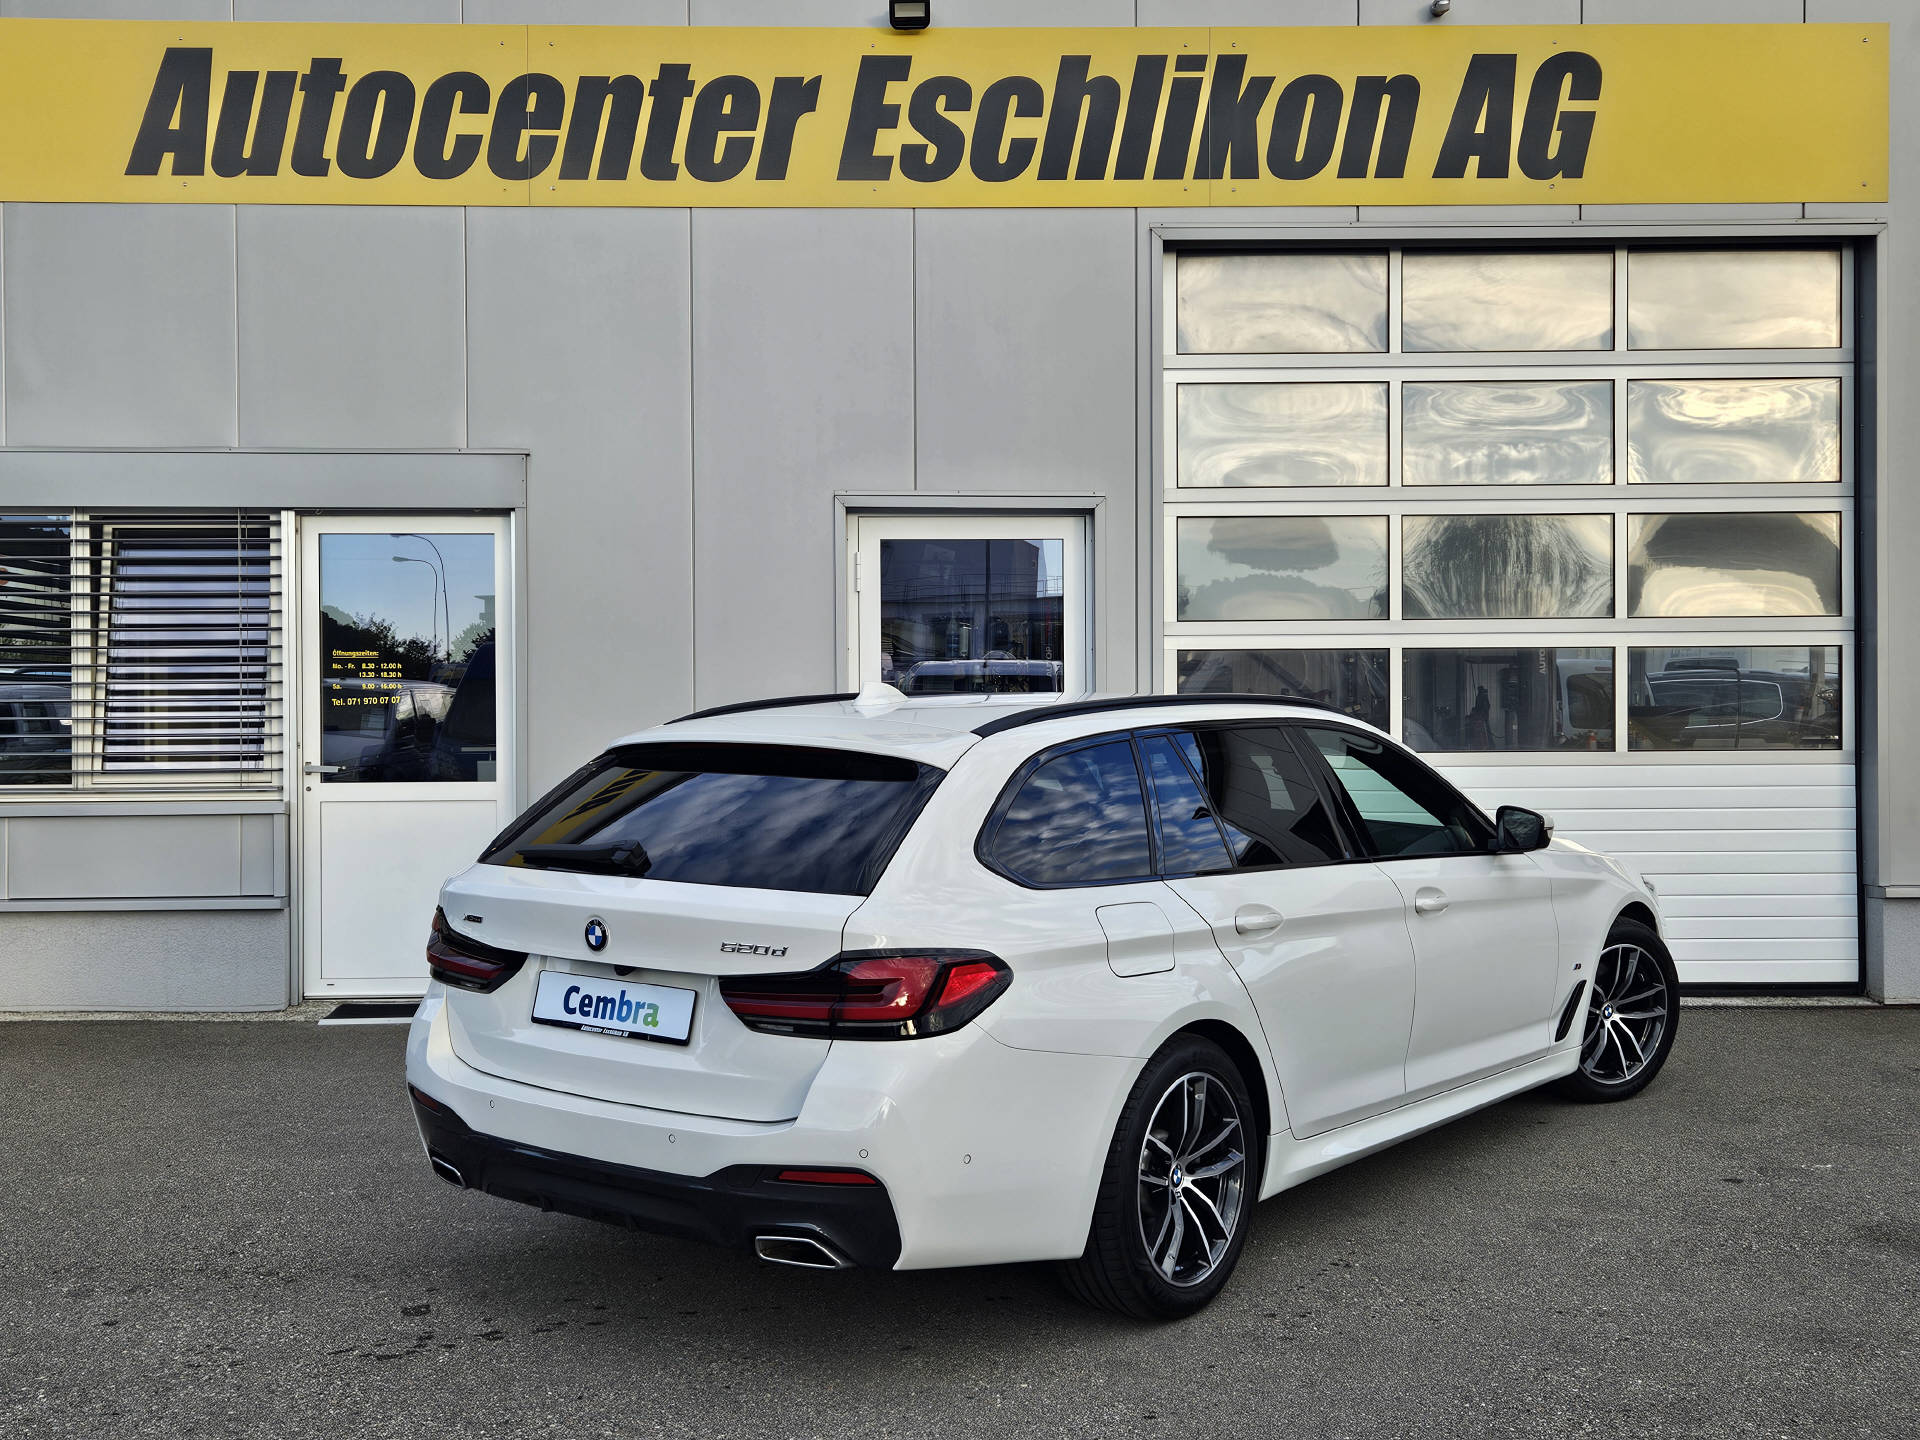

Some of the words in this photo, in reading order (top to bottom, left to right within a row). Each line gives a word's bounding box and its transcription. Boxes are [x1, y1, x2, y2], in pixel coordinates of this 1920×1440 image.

[124, 47, 822, 182] Autocenter
[836, 53, 1422, 182] Eschlikon
[1432, 51, 1602, 181] AG
[332, 698, 346, 706] Tel.
[347, 698, 361, 706] 071
[363, 697, 378, 705] 970
[380, 696, 389, 704] 07
[391, 696, 401, 704] 07
[563, 985, 660, 1028] Cembra
